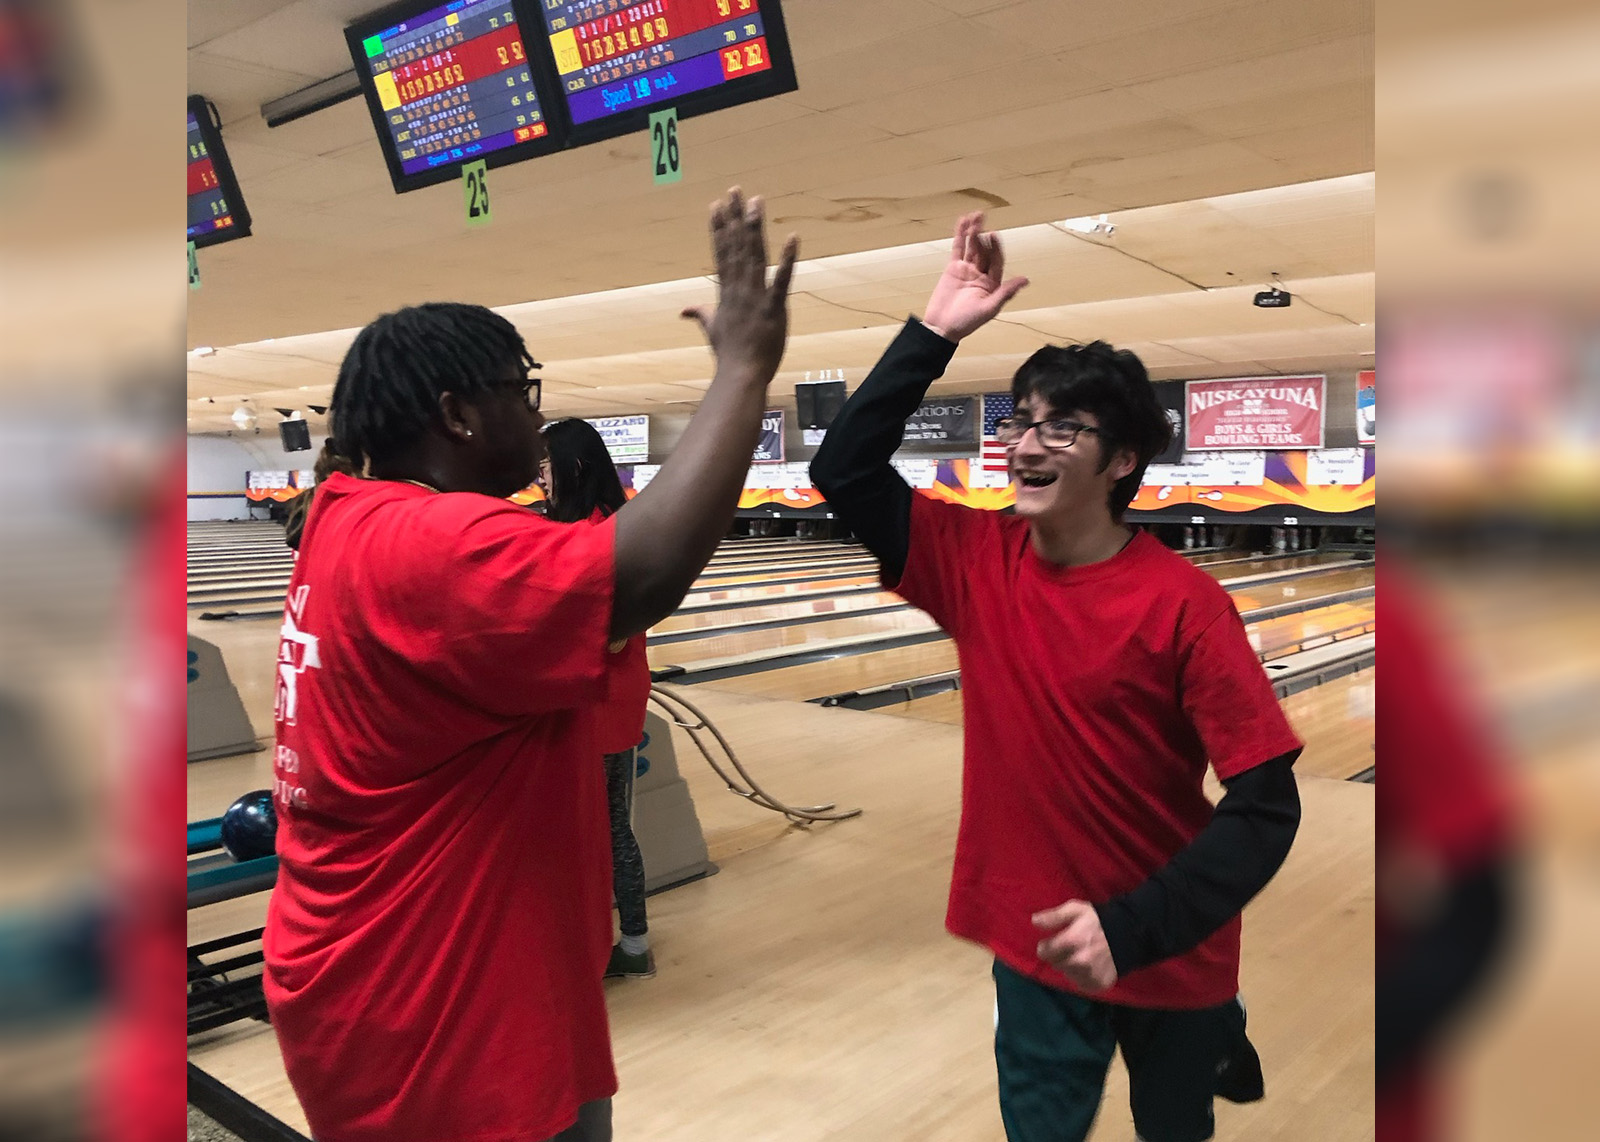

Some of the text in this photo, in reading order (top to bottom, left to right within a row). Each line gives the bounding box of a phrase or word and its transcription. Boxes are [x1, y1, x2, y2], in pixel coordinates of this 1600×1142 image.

[489, 18, 498, 28] 72
[504, 12, 513, 22] 72
[724, 30, 736, 42] 70
[743, 24, 756, 36] 70
[511, 96, 521, 106] 65
[526, 91, 535, 101] 65
[654, 117, 679, 175] 26
[467, 168, 489, 217] 25
[1191, 387, 1318, 414] NISKAYUNA
[762, 417, 782, 434] DY
[1215, 424, 1292, 434] BOYS & GIRLS
[1205, 433, 1302, 445] BOWLING TEAMS
